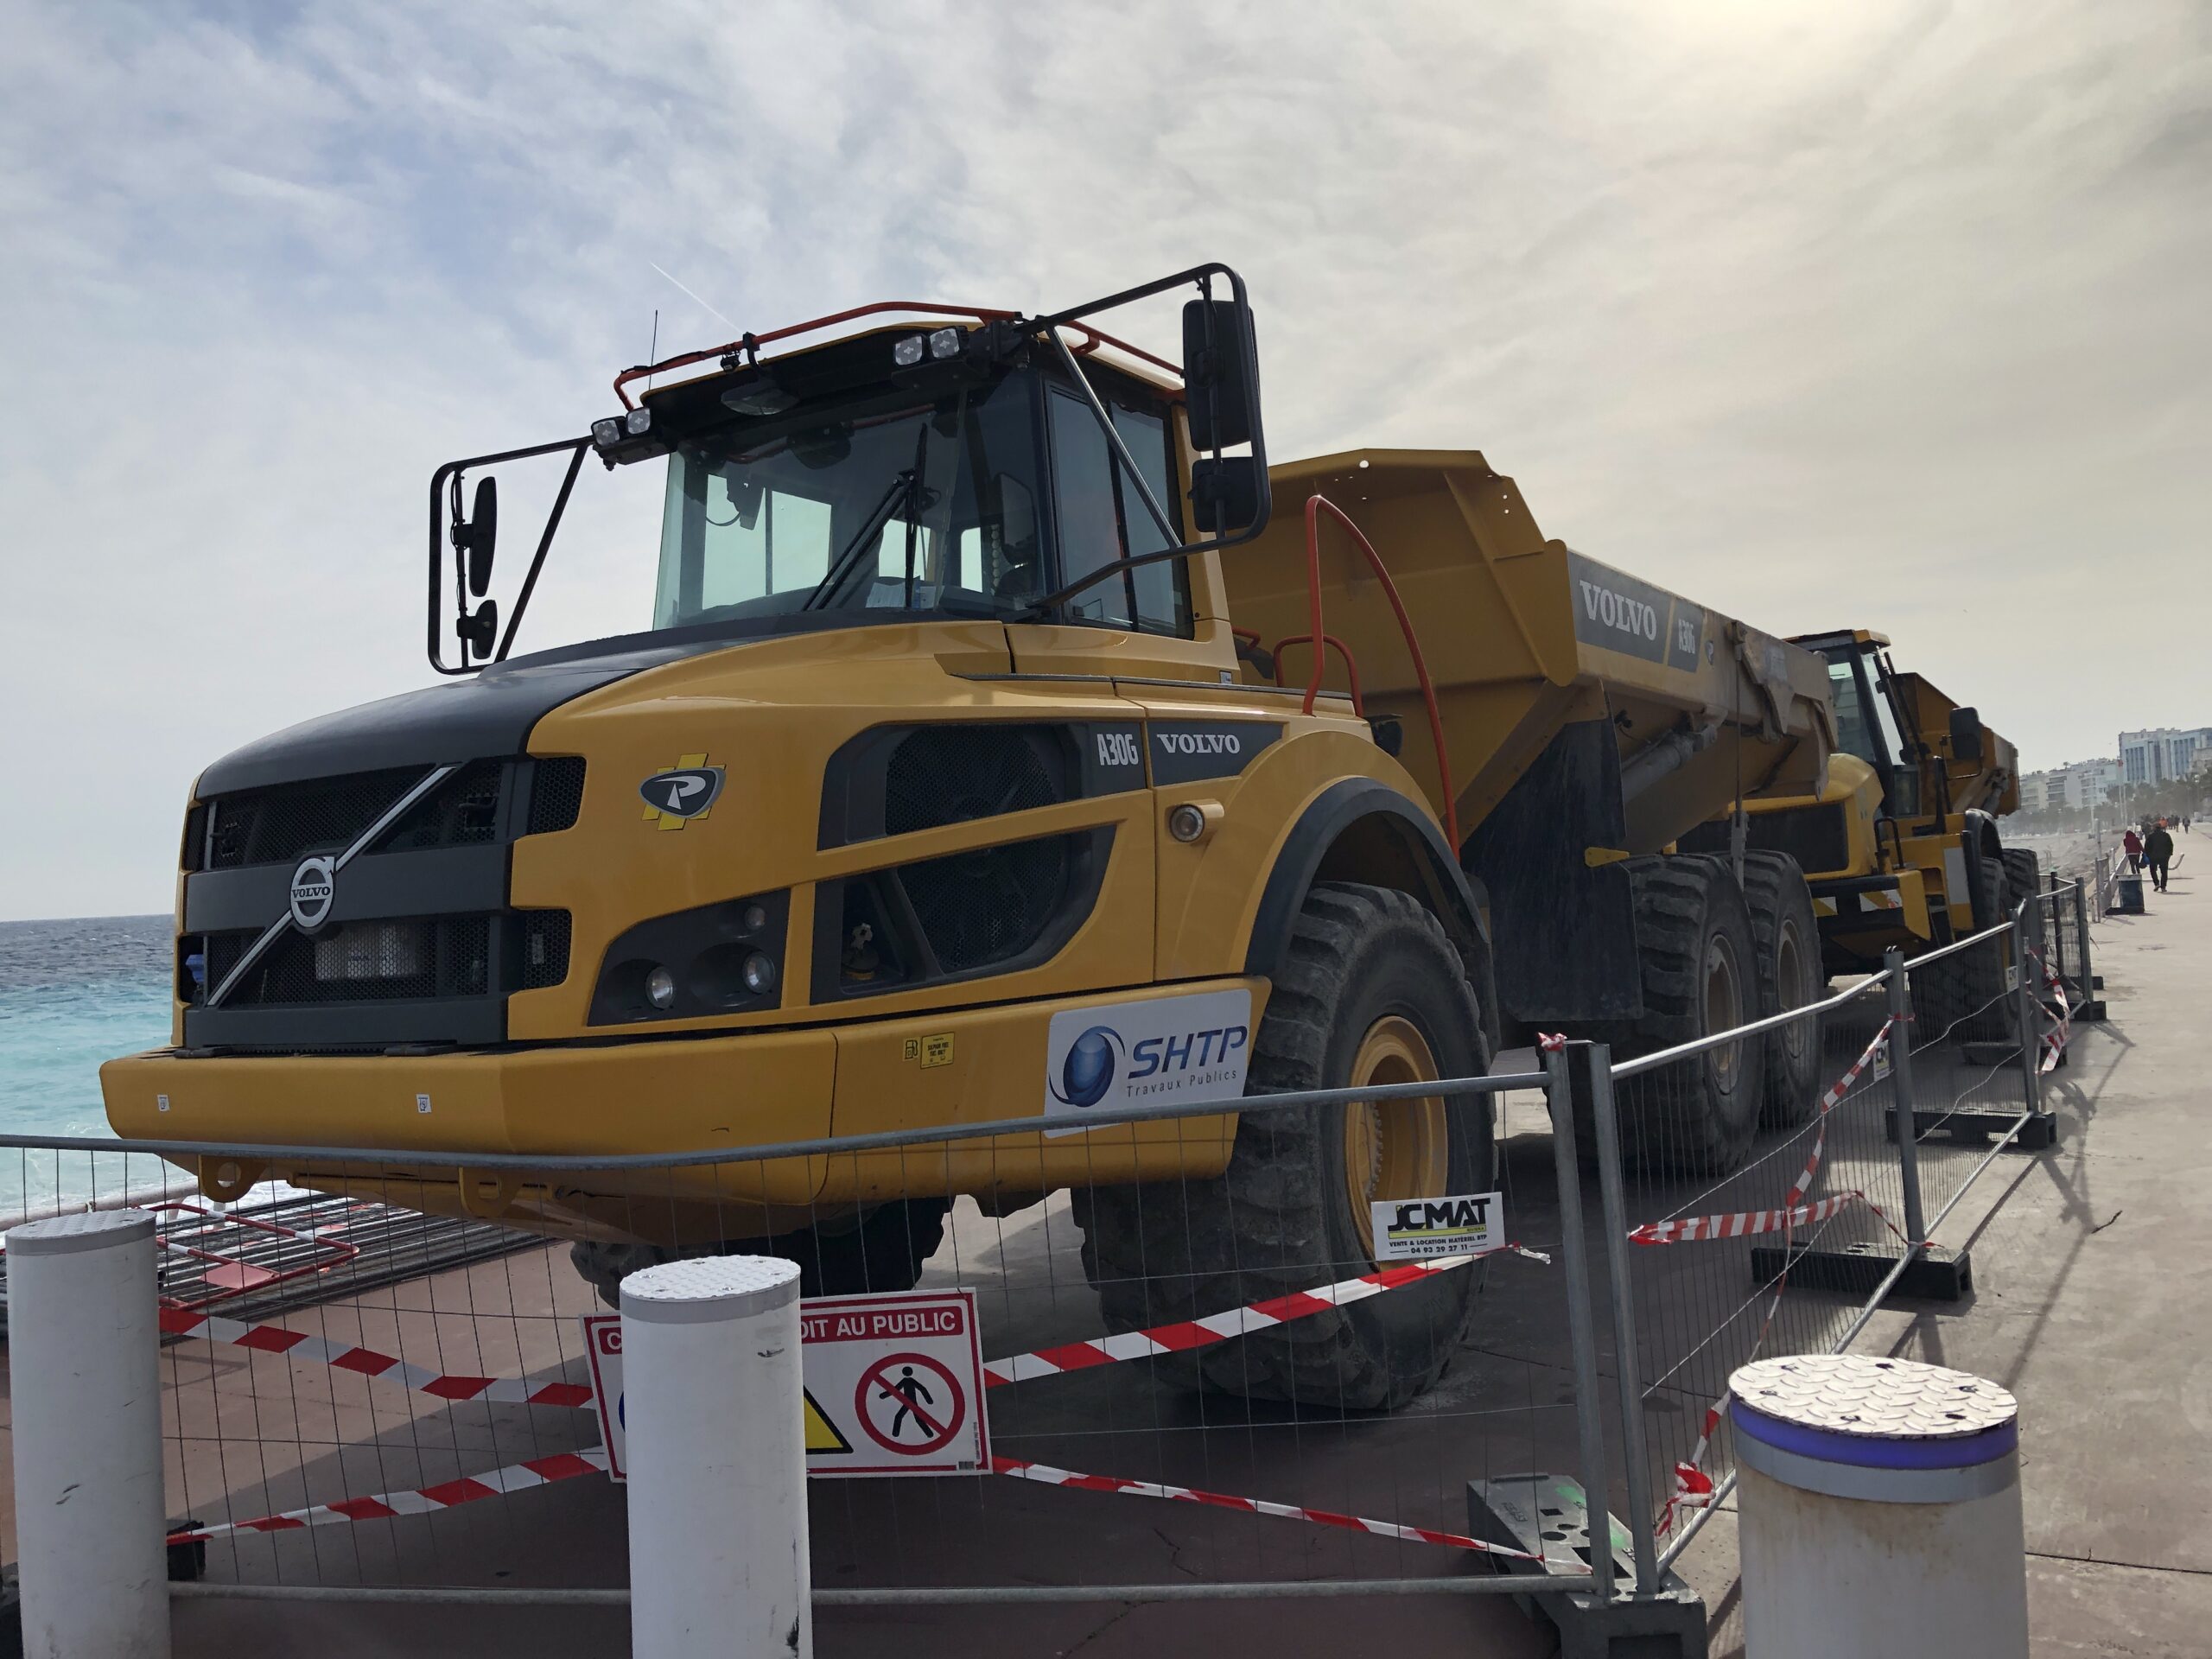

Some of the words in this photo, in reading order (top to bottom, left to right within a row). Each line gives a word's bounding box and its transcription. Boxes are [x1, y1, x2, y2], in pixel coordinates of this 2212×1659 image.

[1580, 580, 1657, 641] VOLVO
[1096, 733, 1139, 766] A30G
[1156, 734, 1241, 754] VOLVO
[291, 886, 331, 899] VOLVO
[1128, 1026, 1248, 1079] SHTP
[1127, 1079, 1181, 1097] Travaux
[1189, 1070, 1237, 1086] Publics
[1388, 1198, 1491, 1231] JCMAT
[1416, 1237, 1446, 1246] LOCATION
[836, 1316, 866, 1337] AU
[873, 1311, 956, 1334] PUBLIC
